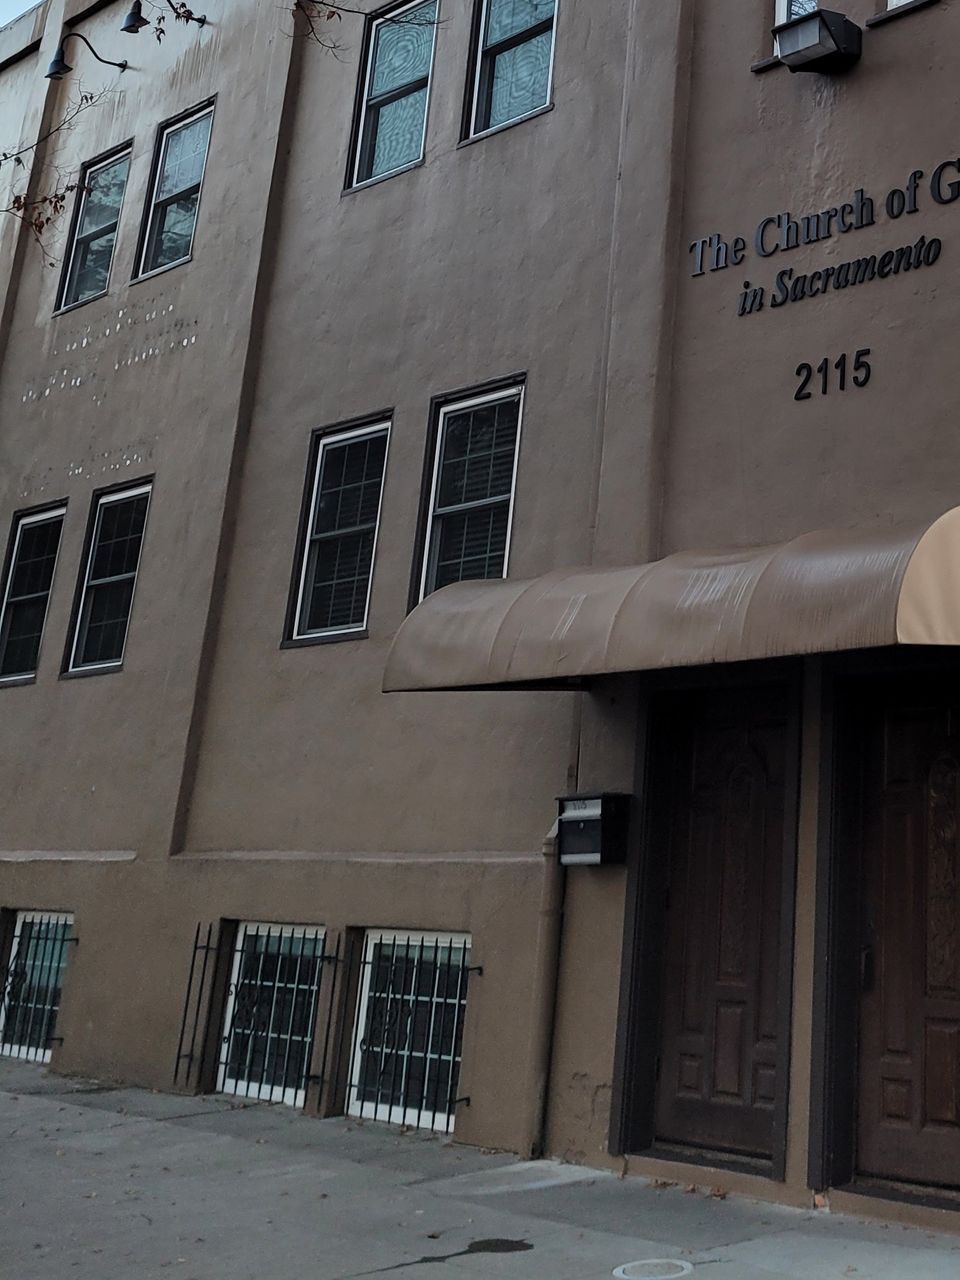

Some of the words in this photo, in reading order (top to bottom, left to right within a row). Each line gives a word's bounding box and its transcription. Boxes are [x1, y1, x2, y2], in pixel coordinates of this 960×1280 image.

[689, 233, 746, 277] The
[754, 189, 875, 258] Church
[886, 170, 924, 219] of
[737, 281, 764, 317] in
[770, 235, 942, 308] Sacramento
[794, 348, 871, 401] 2115
